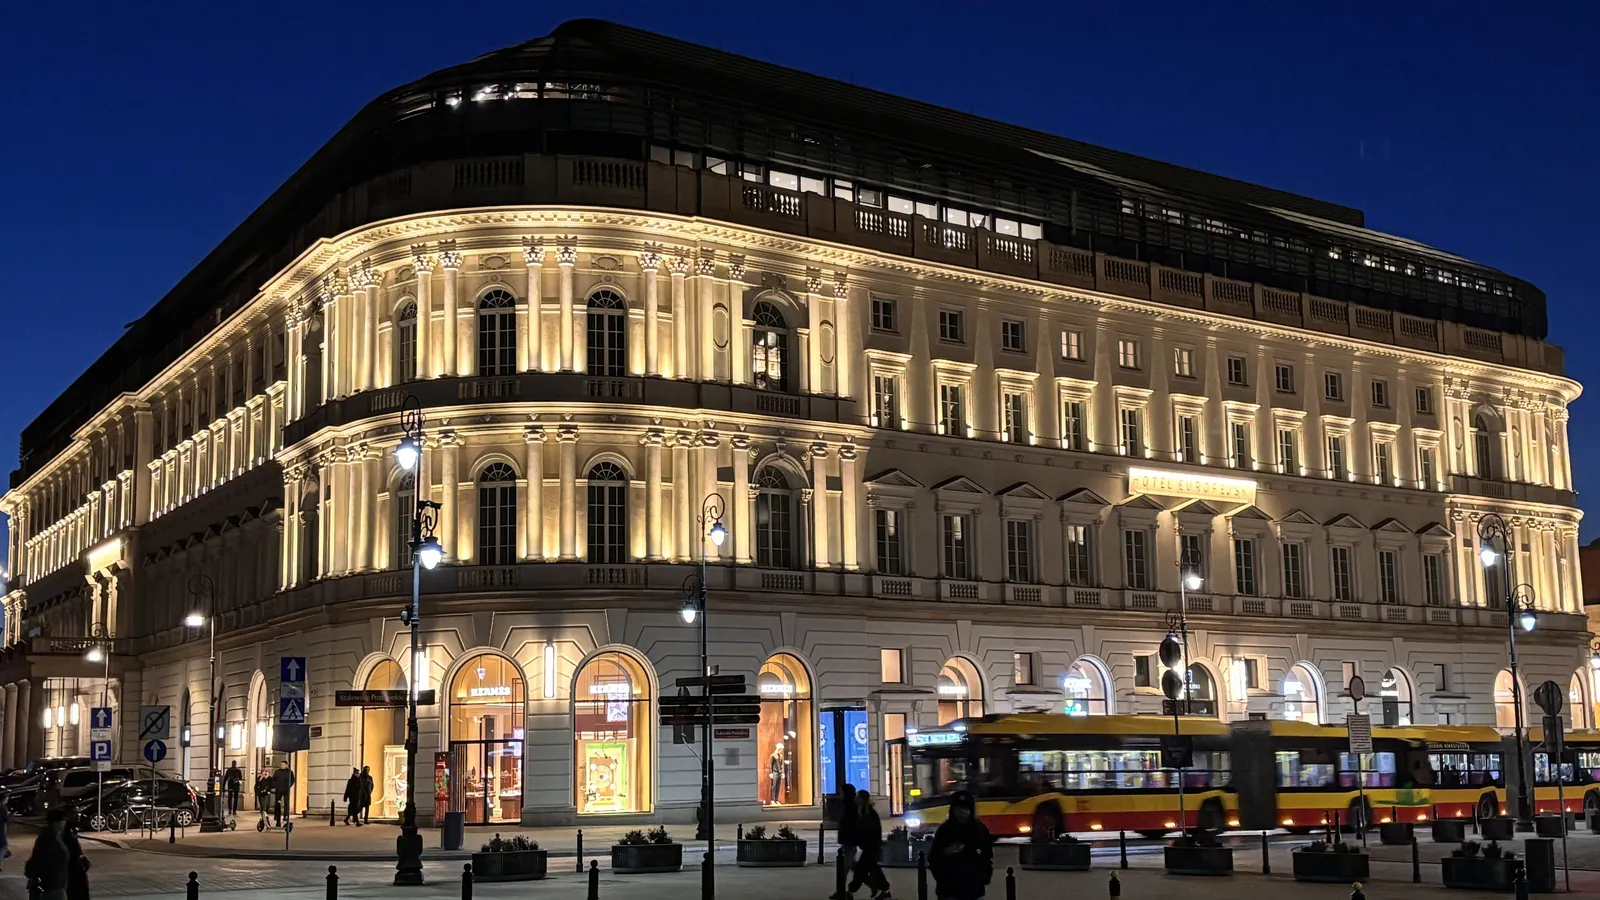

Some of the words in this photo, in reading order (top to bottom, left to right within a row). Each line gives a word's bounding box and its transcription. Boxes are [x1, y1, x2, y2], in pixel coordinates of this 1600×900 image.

[1133, 475, 1172, 489] HOTEL
[1178, 480, 1251, 497] EUROPEJSK
[95, 743, 107, 759] P
